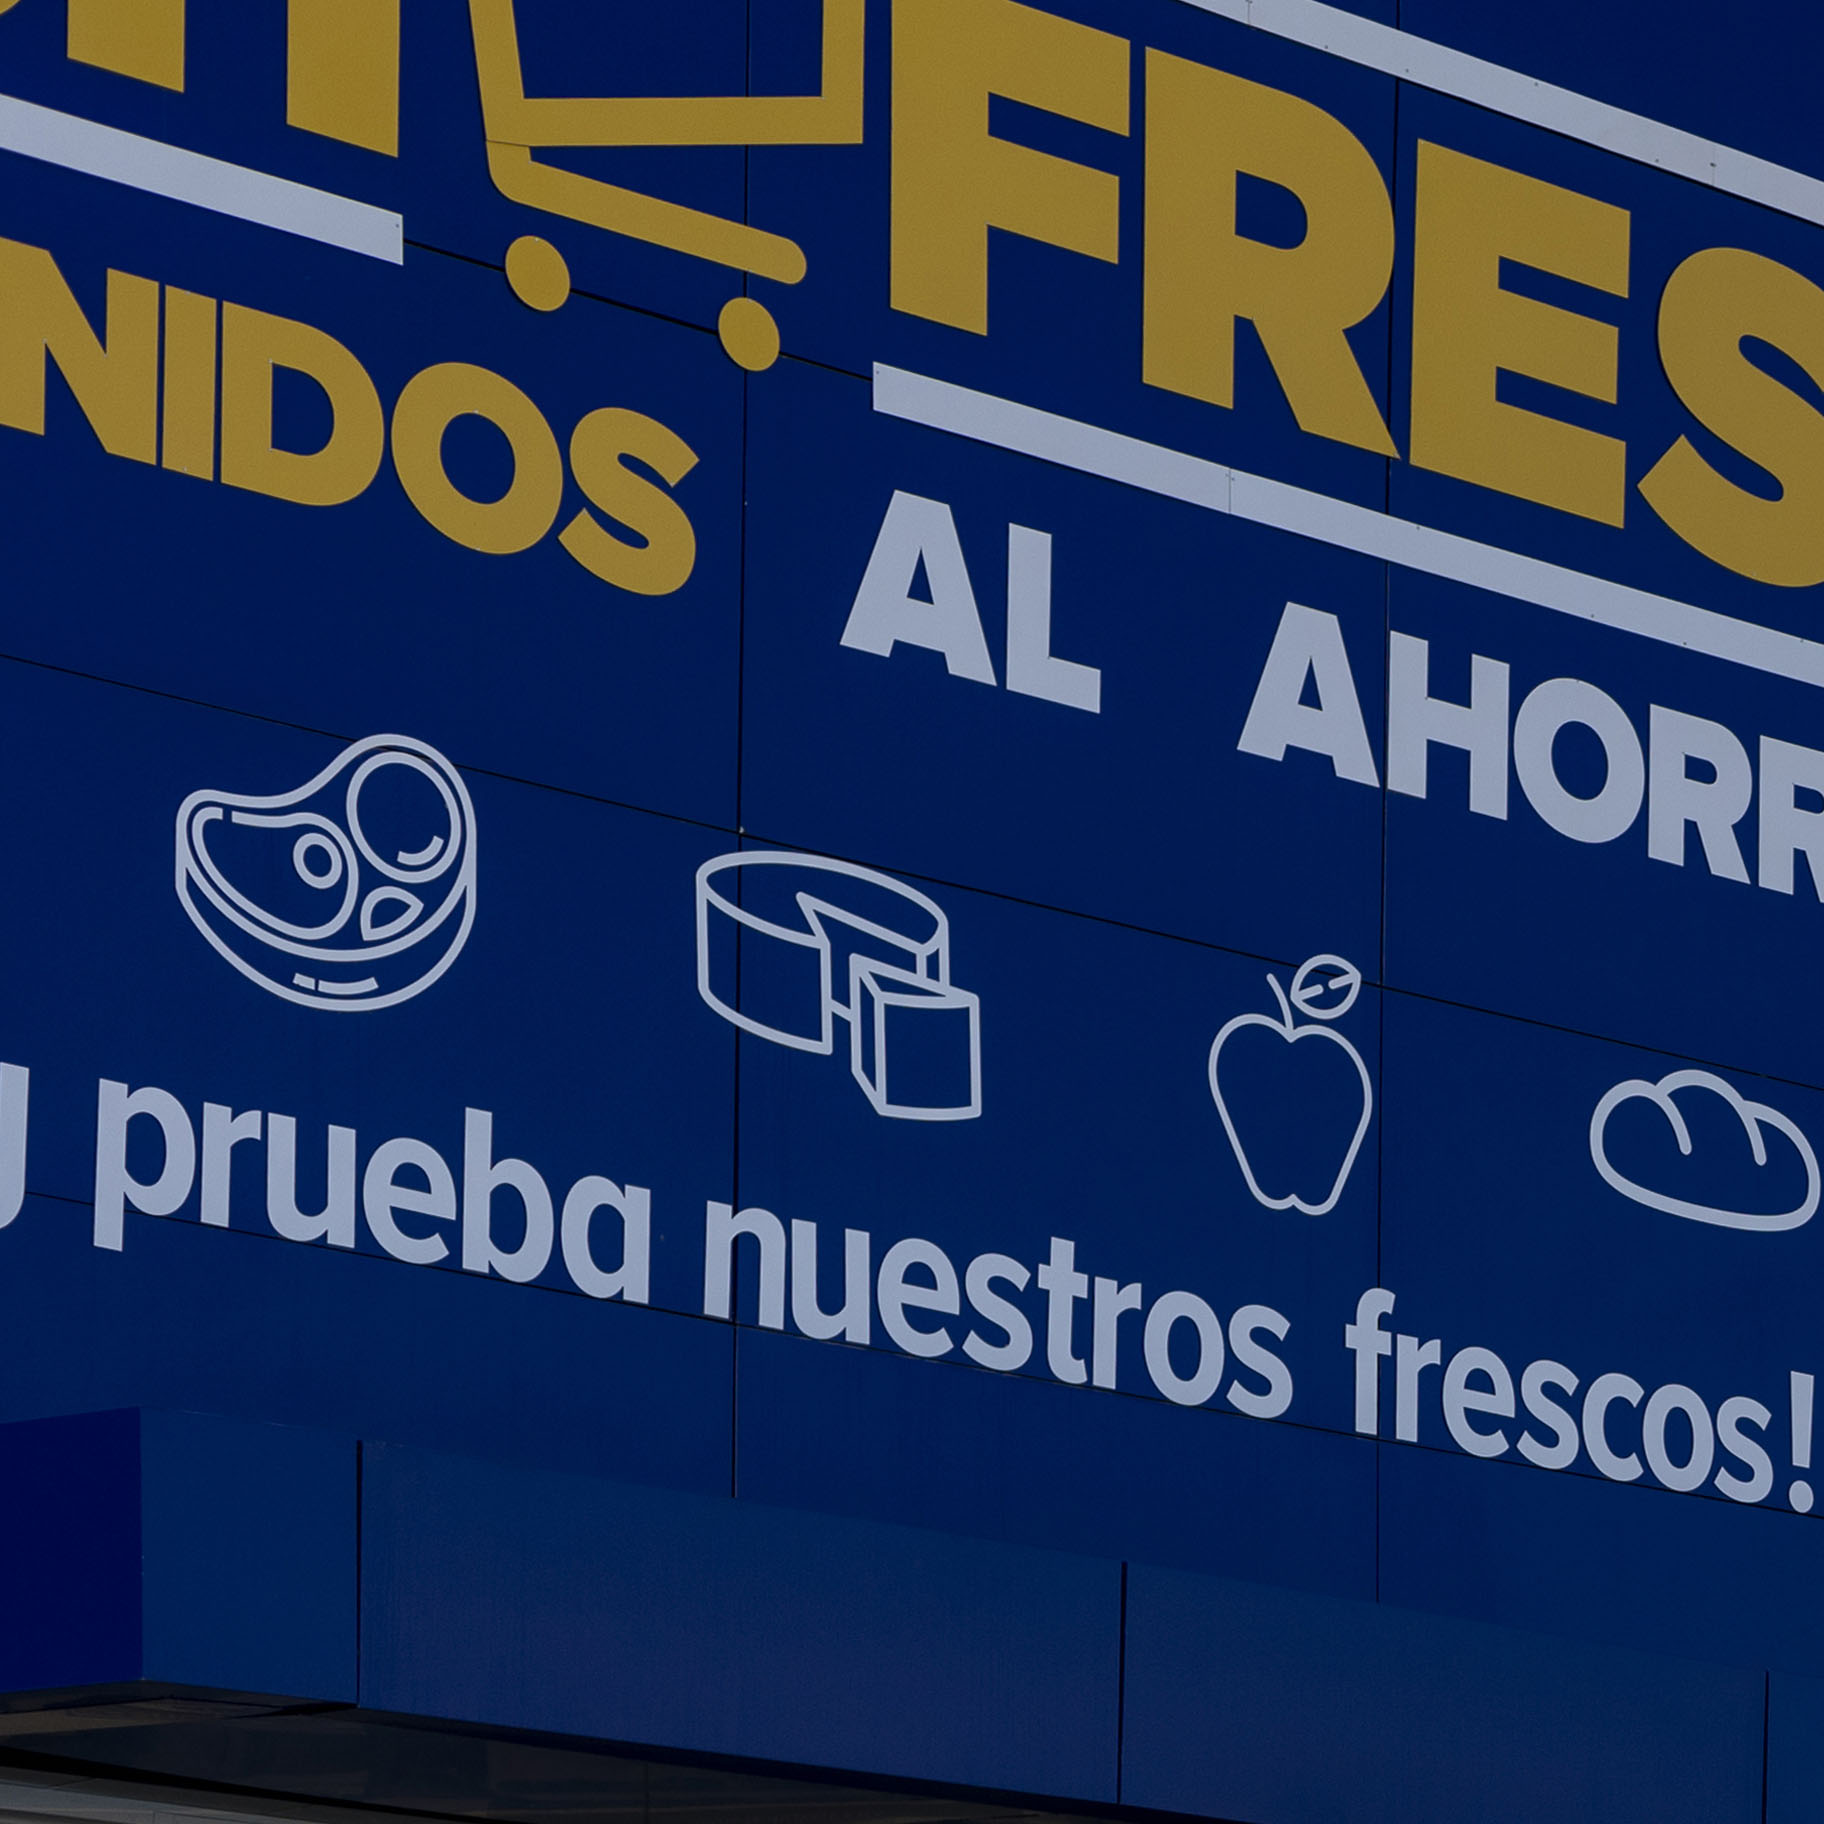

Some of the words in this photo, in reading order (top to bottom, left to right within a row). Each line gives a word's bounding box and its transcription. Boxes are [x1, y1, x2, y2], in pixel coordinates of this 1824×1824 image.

[840, 490, 1101, 713] AL
[93, 1078, 651, 1304] prueba
[704, 1200, 1293, 1418] nuestros
[1346, 1288, 1816, 1513] frescos!
